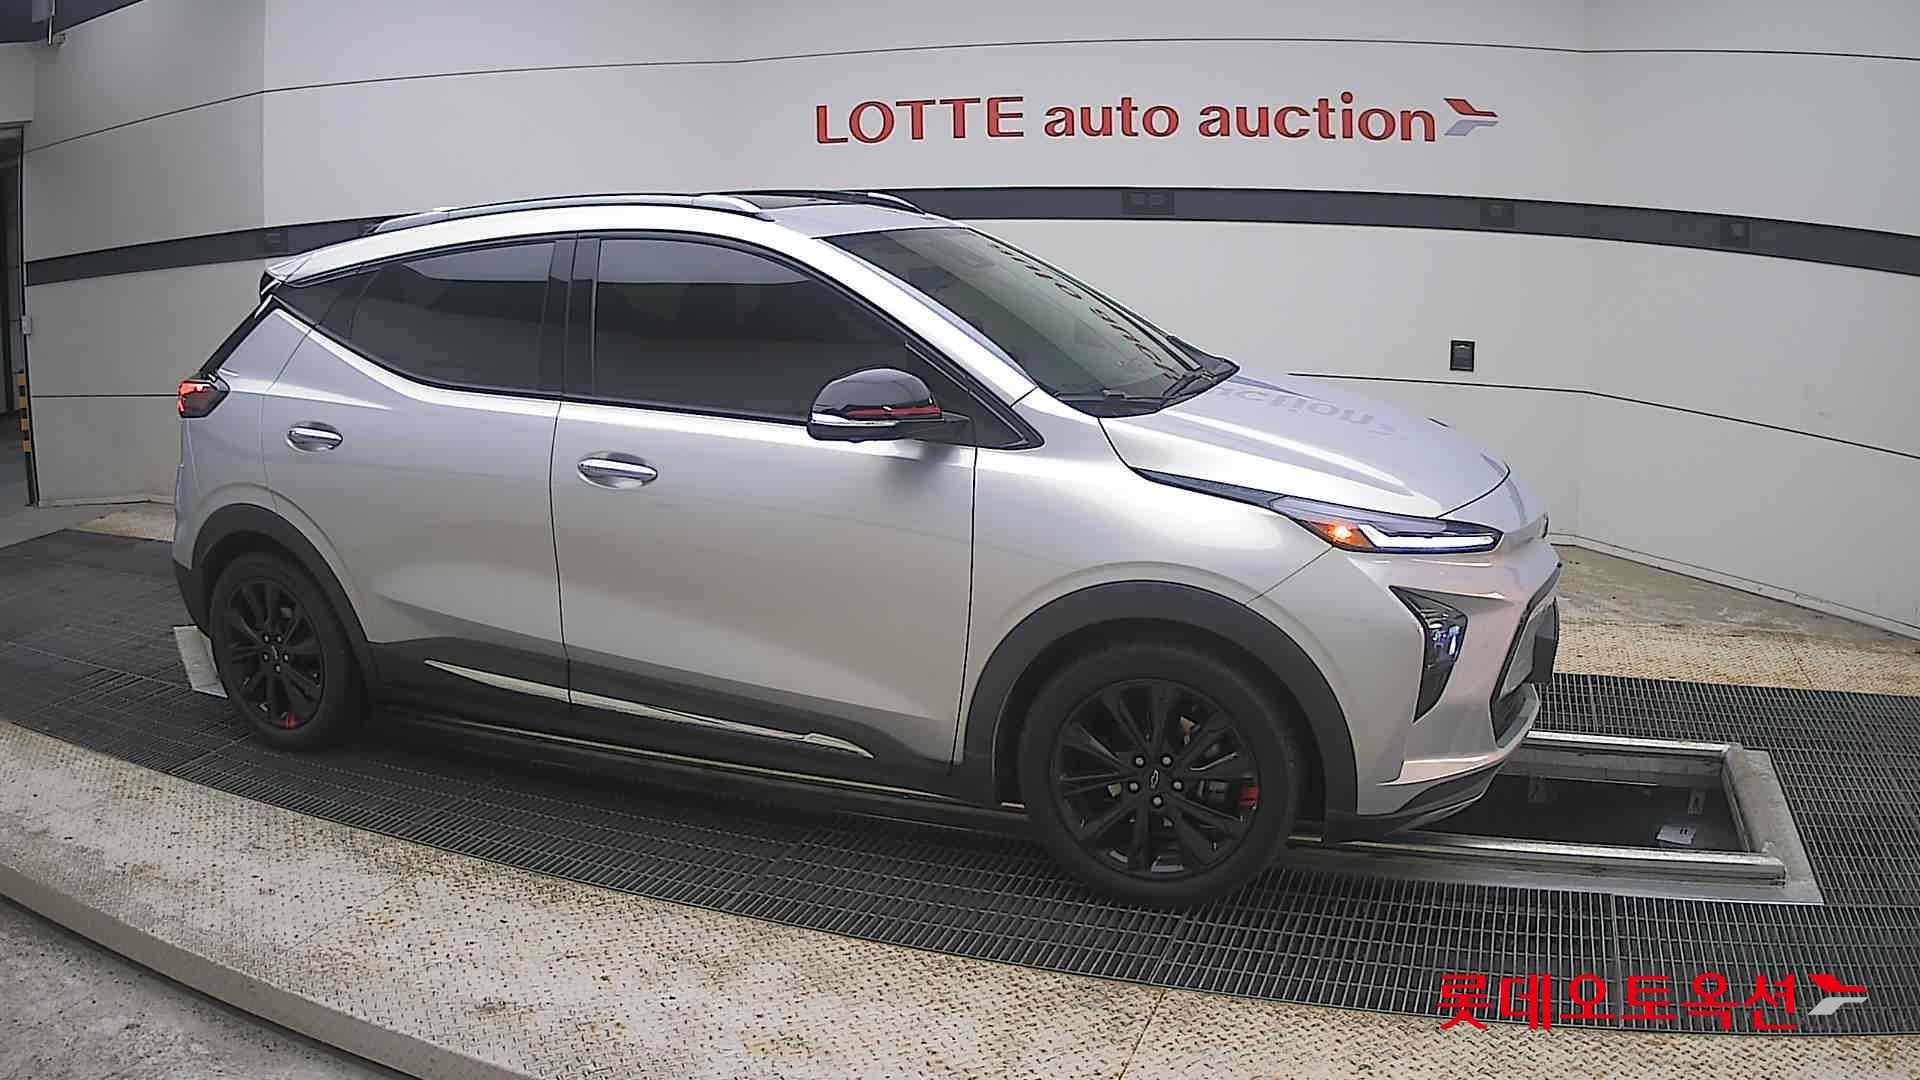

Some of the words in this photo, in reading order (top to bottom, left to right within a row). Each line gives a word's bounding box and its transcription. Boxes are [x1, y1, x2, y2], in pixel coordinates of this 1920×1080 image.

[816, 96, 1024, 144] LOTTE
[1044, 97, 1179, 137] auto
[1199, 91, 1436, 142] auction
